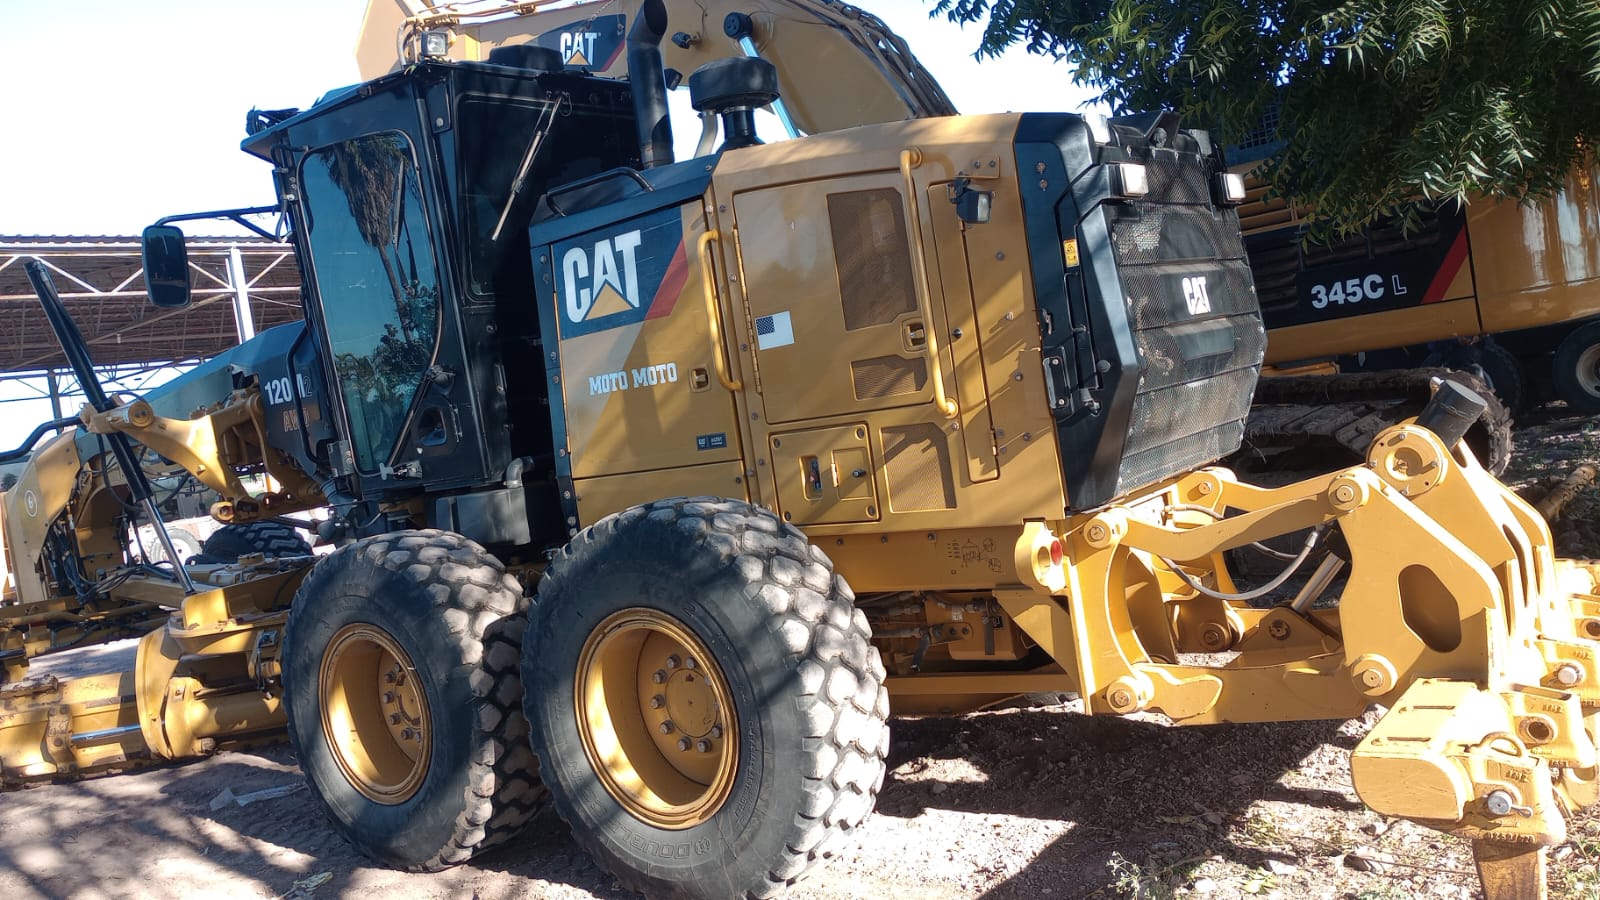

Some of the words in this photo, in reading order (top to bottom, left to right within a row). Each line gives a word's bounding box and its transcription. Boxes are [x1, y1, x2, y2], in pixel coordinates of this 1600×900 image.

[560, 32, 597, 66] CAT
[562, 229, 642, 323] CAT
[1311, 274, 1384, 310] 345C
[1392, 274, 1408, 296] L
[1182, 276, 1211, 315] CAT
[588, 371, 628, 396] MOTO
[631, 362, 678, 388] MOTO
